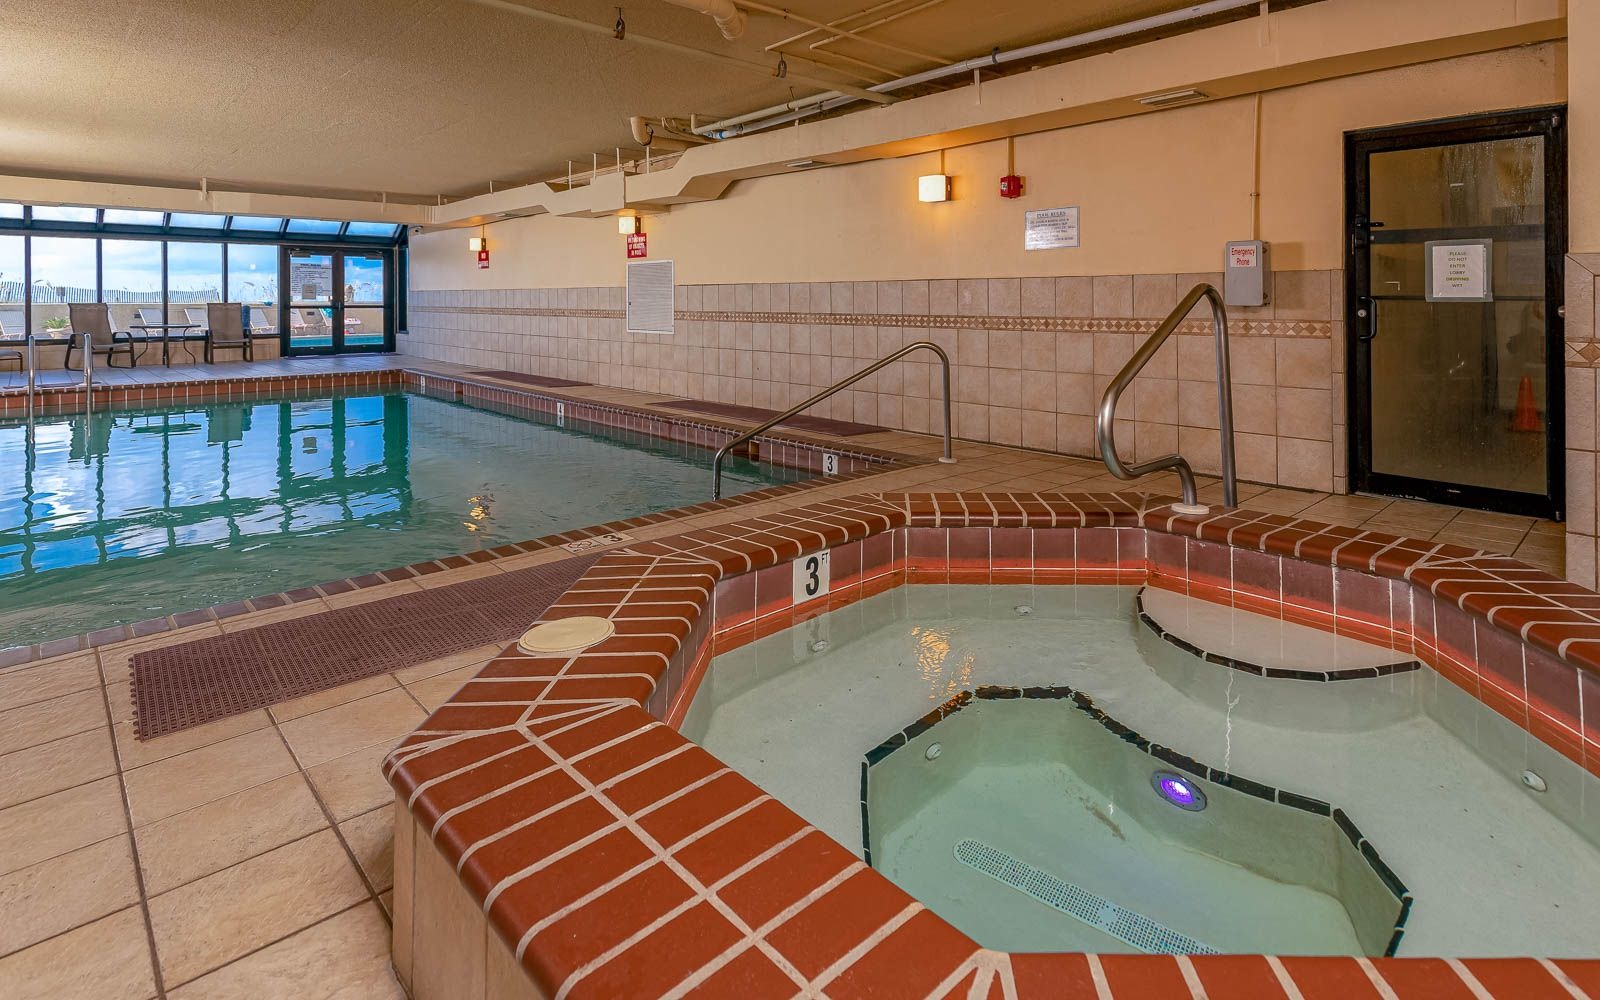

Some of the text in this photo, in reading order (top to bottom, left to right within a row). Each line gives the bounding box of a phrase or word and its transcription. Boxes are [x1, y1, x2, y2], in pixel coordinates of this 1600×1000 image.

[1231, 247, 1255, 257] Emergency
[1236, 257, 1250, 266] Phone
[827, 455, 833, 472] 3
[805, 552, 829, 596] 3 FT
